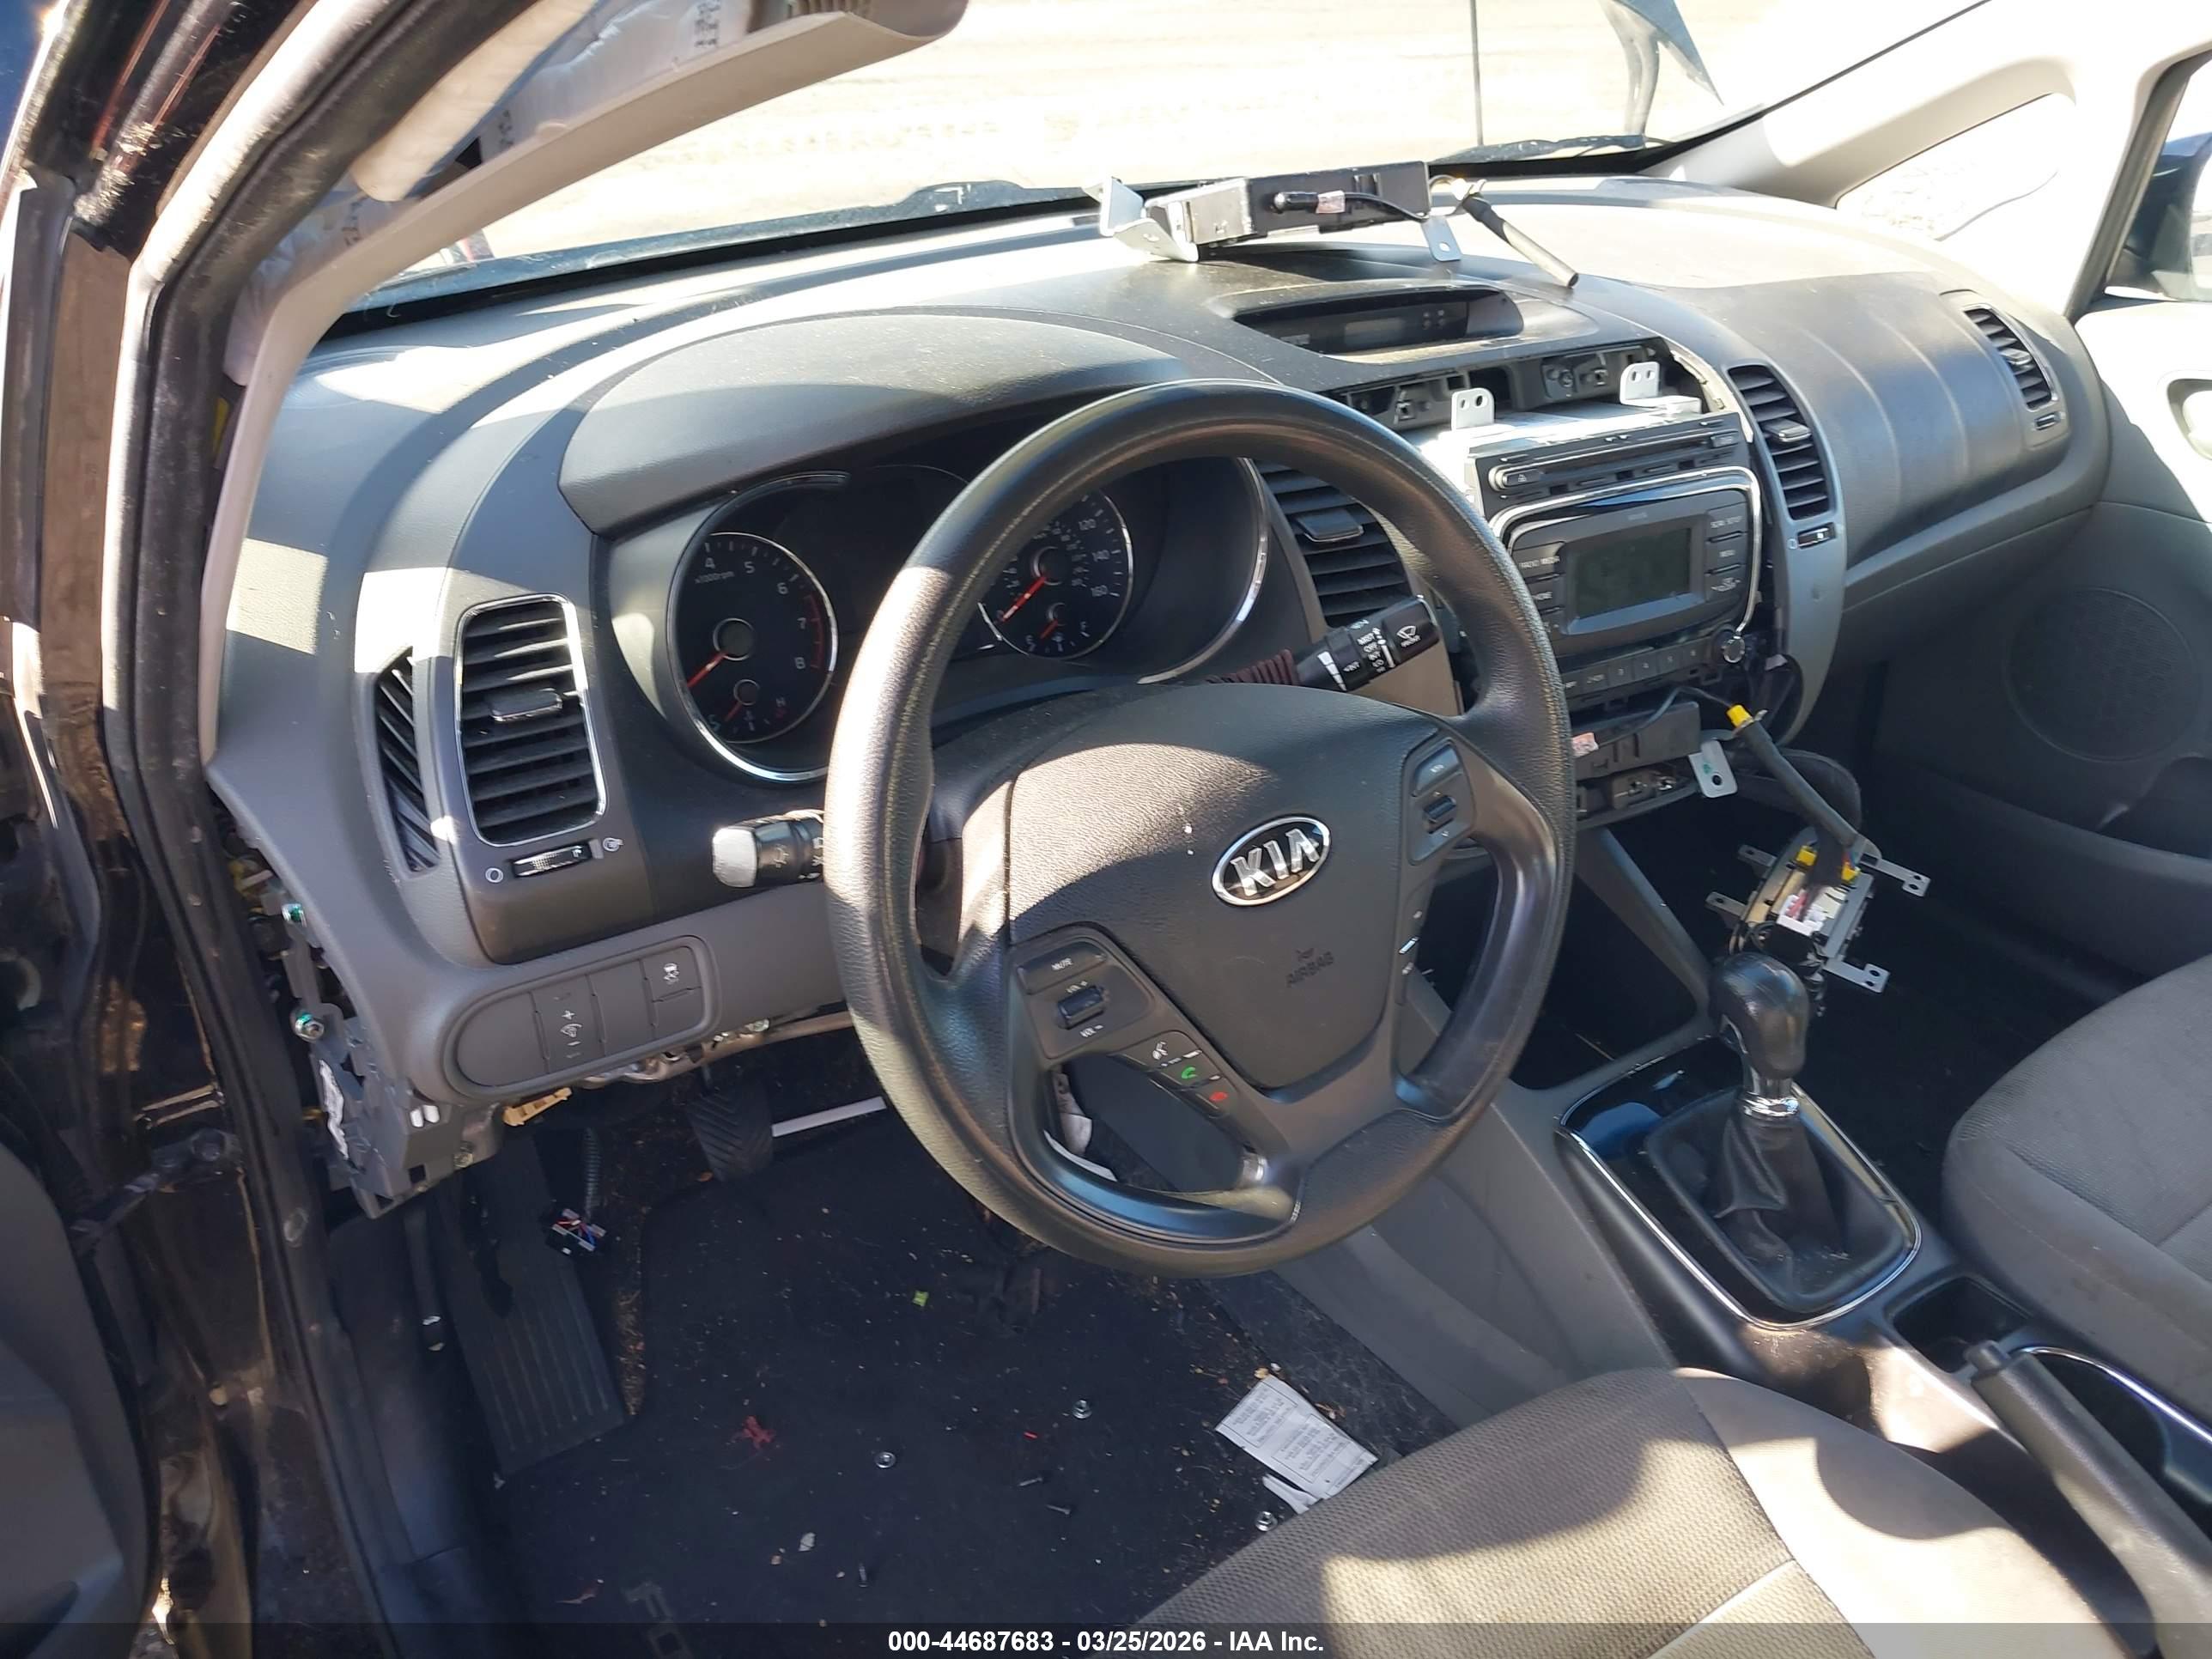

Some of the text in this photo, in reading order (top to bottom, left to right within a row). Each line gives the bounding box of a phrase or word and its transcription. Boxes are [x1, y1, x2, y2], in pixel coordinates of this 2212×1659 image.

[705, 557, 715, 569] 4
[744, 561, 756, 574] 5
[777, 583, 789, 594] 6
[797, 617, 806, 629] 7
[795, 657, 806, 669] 8
[1230, 828, 1321, 896] KIA
[1051, 957, 1073, 970] MUTE
